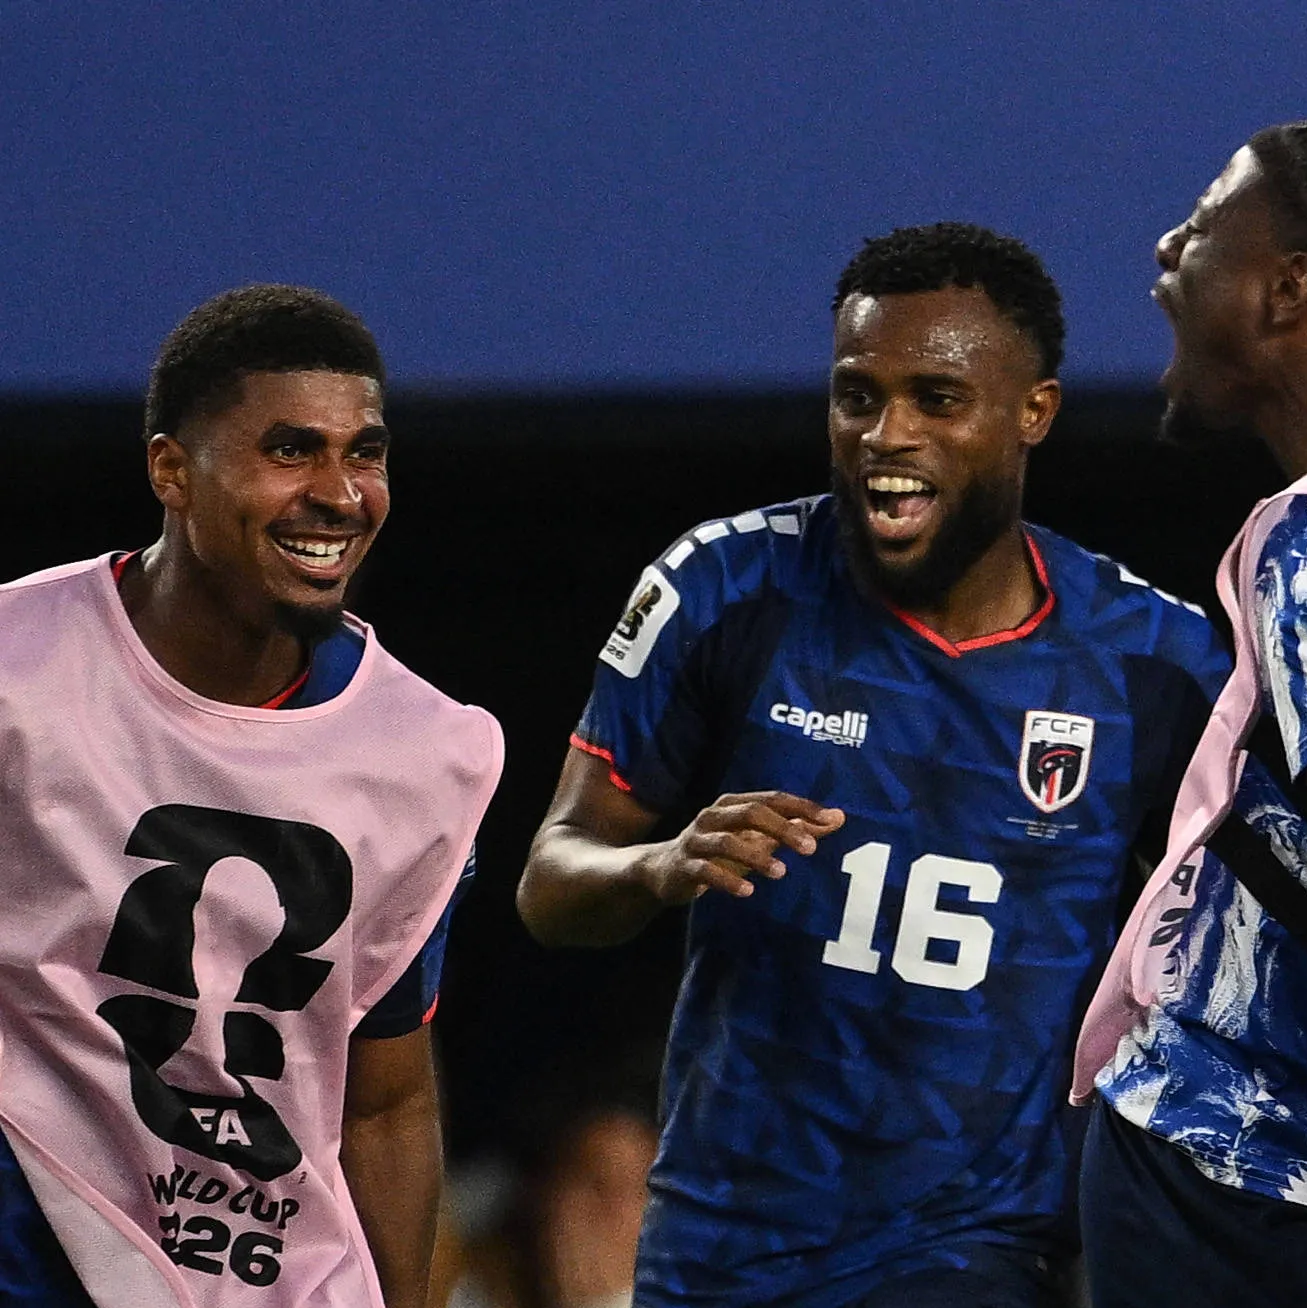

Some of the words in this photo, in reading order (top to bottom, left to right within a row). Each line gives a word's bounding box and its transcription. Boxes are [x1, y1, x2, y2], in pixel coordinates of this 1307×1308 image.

[769, 703, 869, 740] capelli
[811, 731, 865, 749] SPORT
[1031, 717, 1088, 735] FCF
[822, 841, 1003, 991] 16
[147, 1163, 229, 1205] WLD
[229, 1184, 299, 1229] CUP
